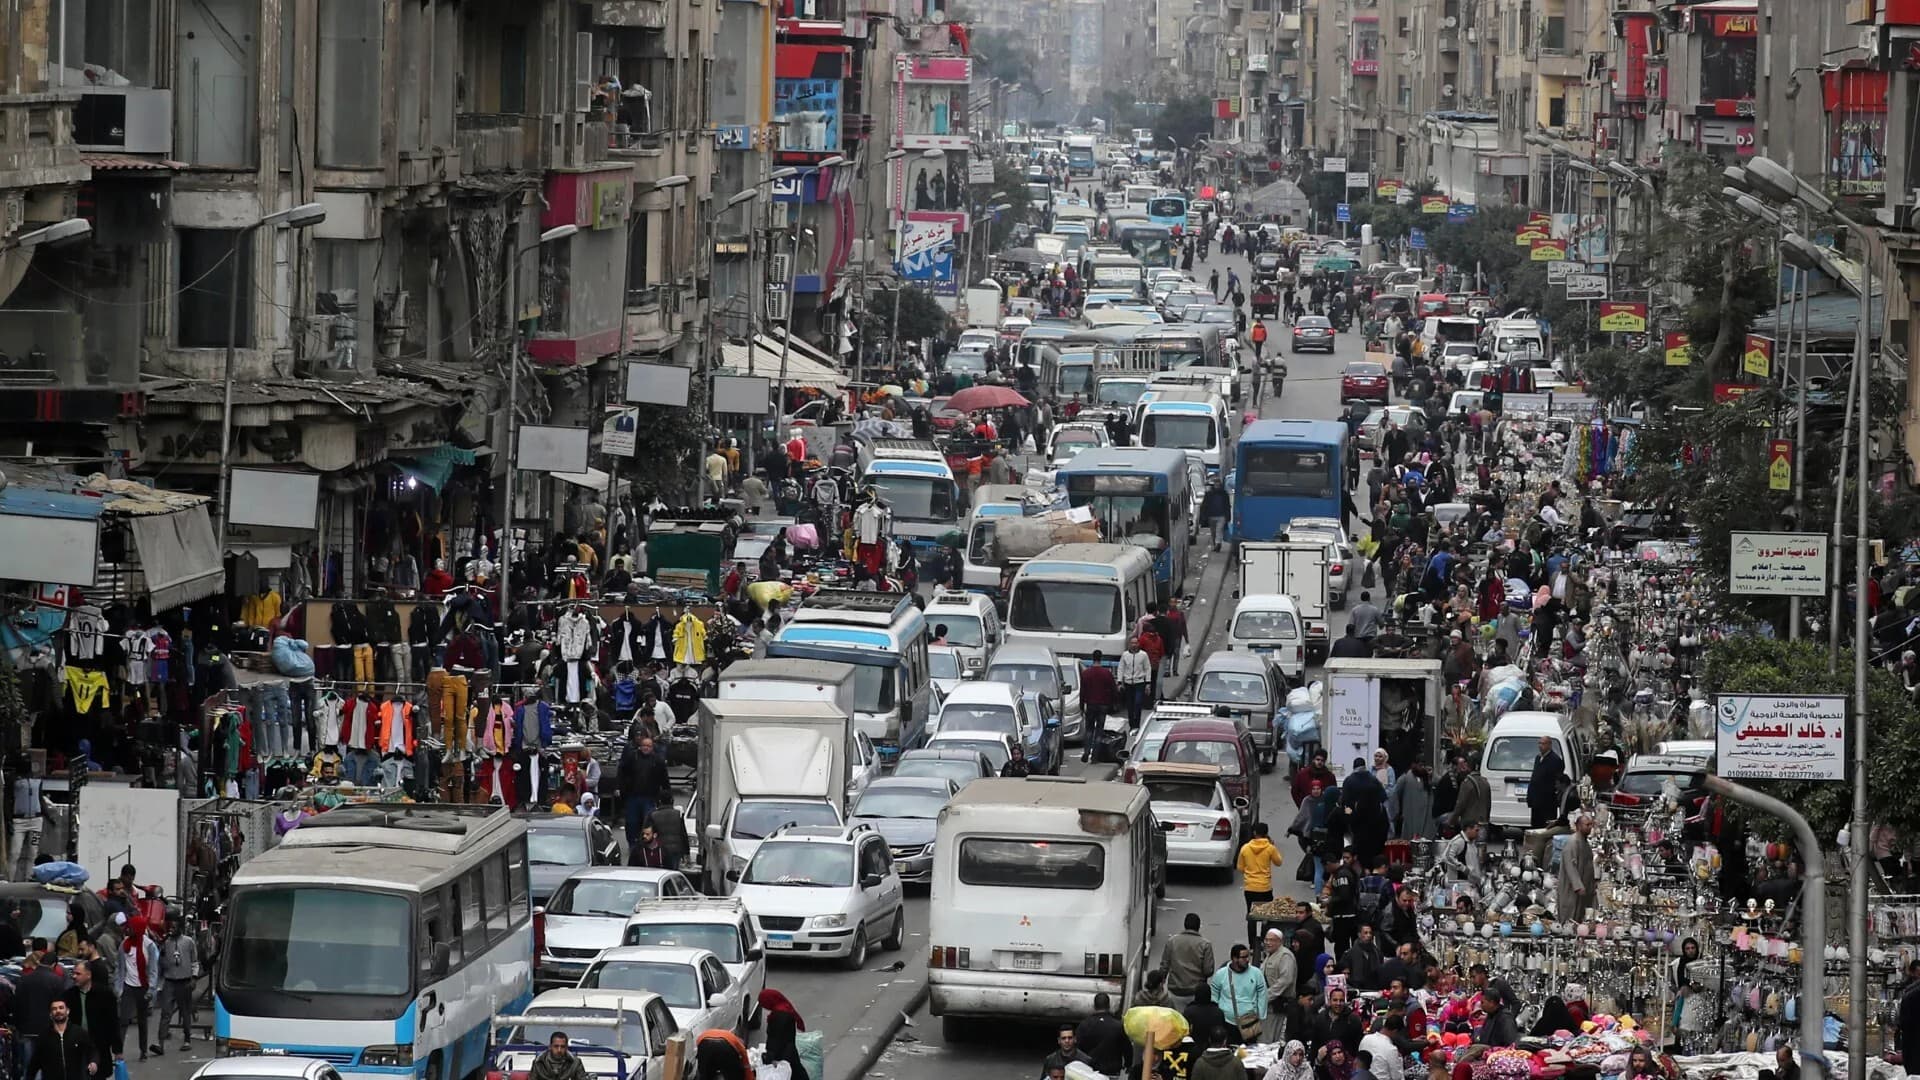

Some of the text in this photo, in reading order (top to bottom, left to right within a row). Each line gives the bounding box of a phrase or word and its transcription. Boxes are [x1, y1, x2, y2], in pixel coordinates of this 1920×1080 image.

[1758, 547, 1787, 557] الشروق
[1780, 563, 1806, 571] هندسة
[1750, 711, 1778, 719] الزوجية
[1797, 721, 1826, 739] خالد
